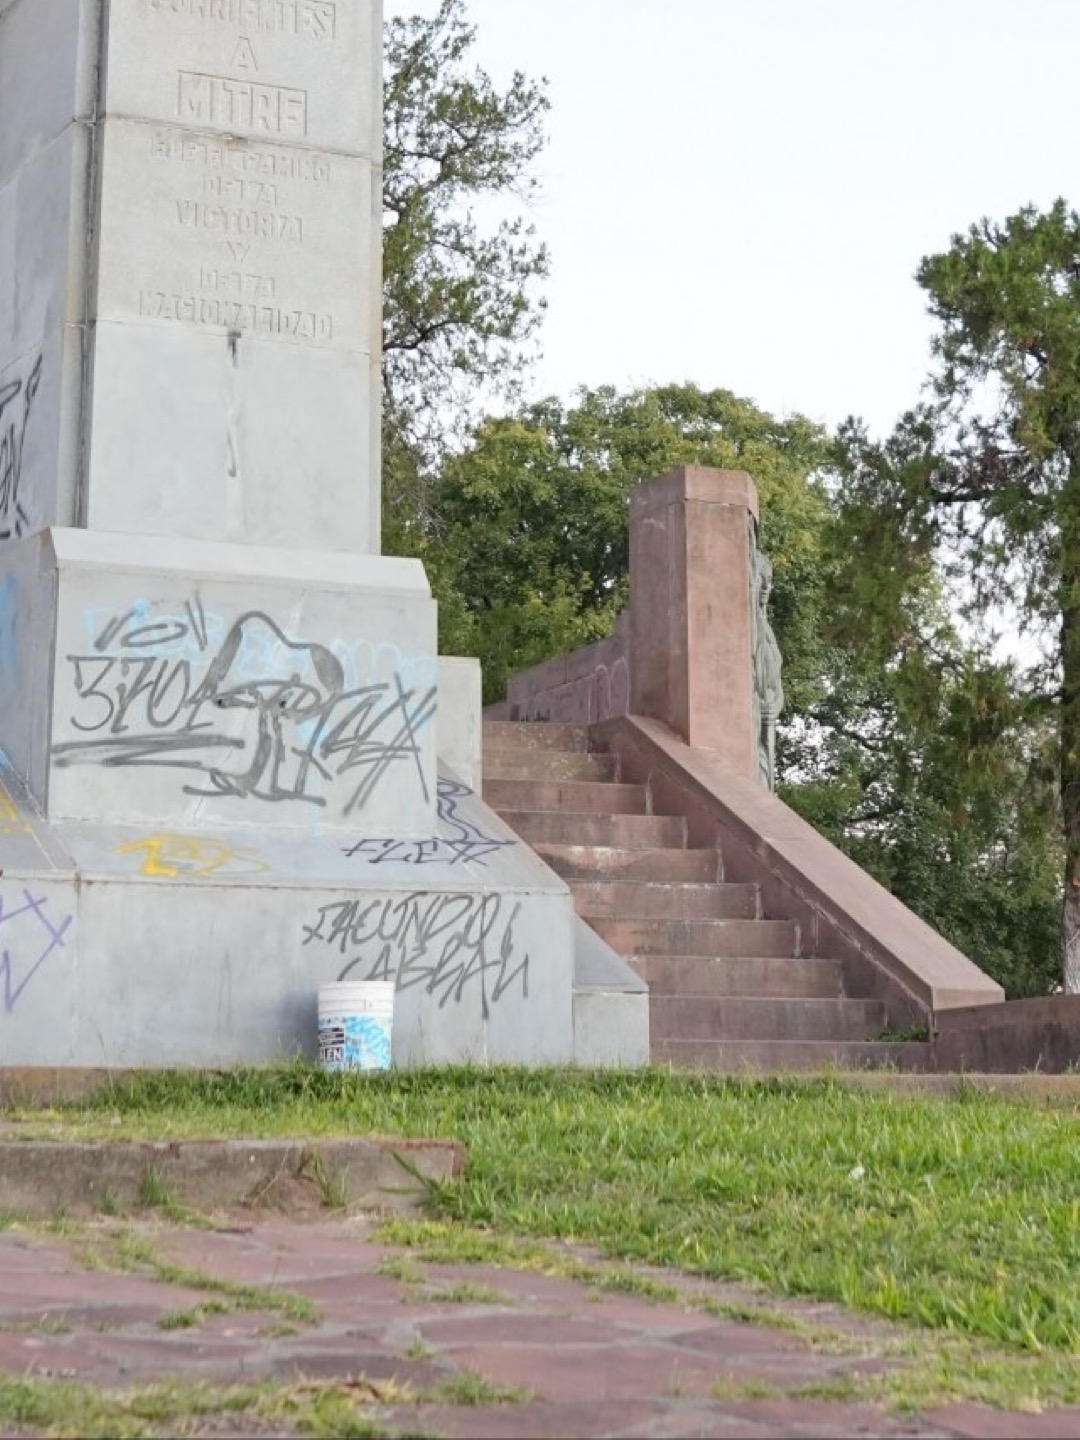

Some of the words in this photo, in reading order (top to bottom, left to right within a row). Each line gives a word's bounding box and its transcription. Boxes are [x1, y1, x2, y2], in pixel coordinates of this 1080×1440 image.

[232, 35, 259, 72] A
[176, 70, 308, 137] MITRE
[243, 150, 333, 185] CAMINO
[202, 171, 234, 198] DE
[241, 180, 277, 207] LA
[176, 198, 304, 243] VICTORIA
[226, 239, 251, 265] Y
[199, 266, 231, 293] DE
[239, 272, 276, 298] LA
[139, 288, 334, 340] NACIONALIDAD
[302, 891, 501, 954] FACUNDO
